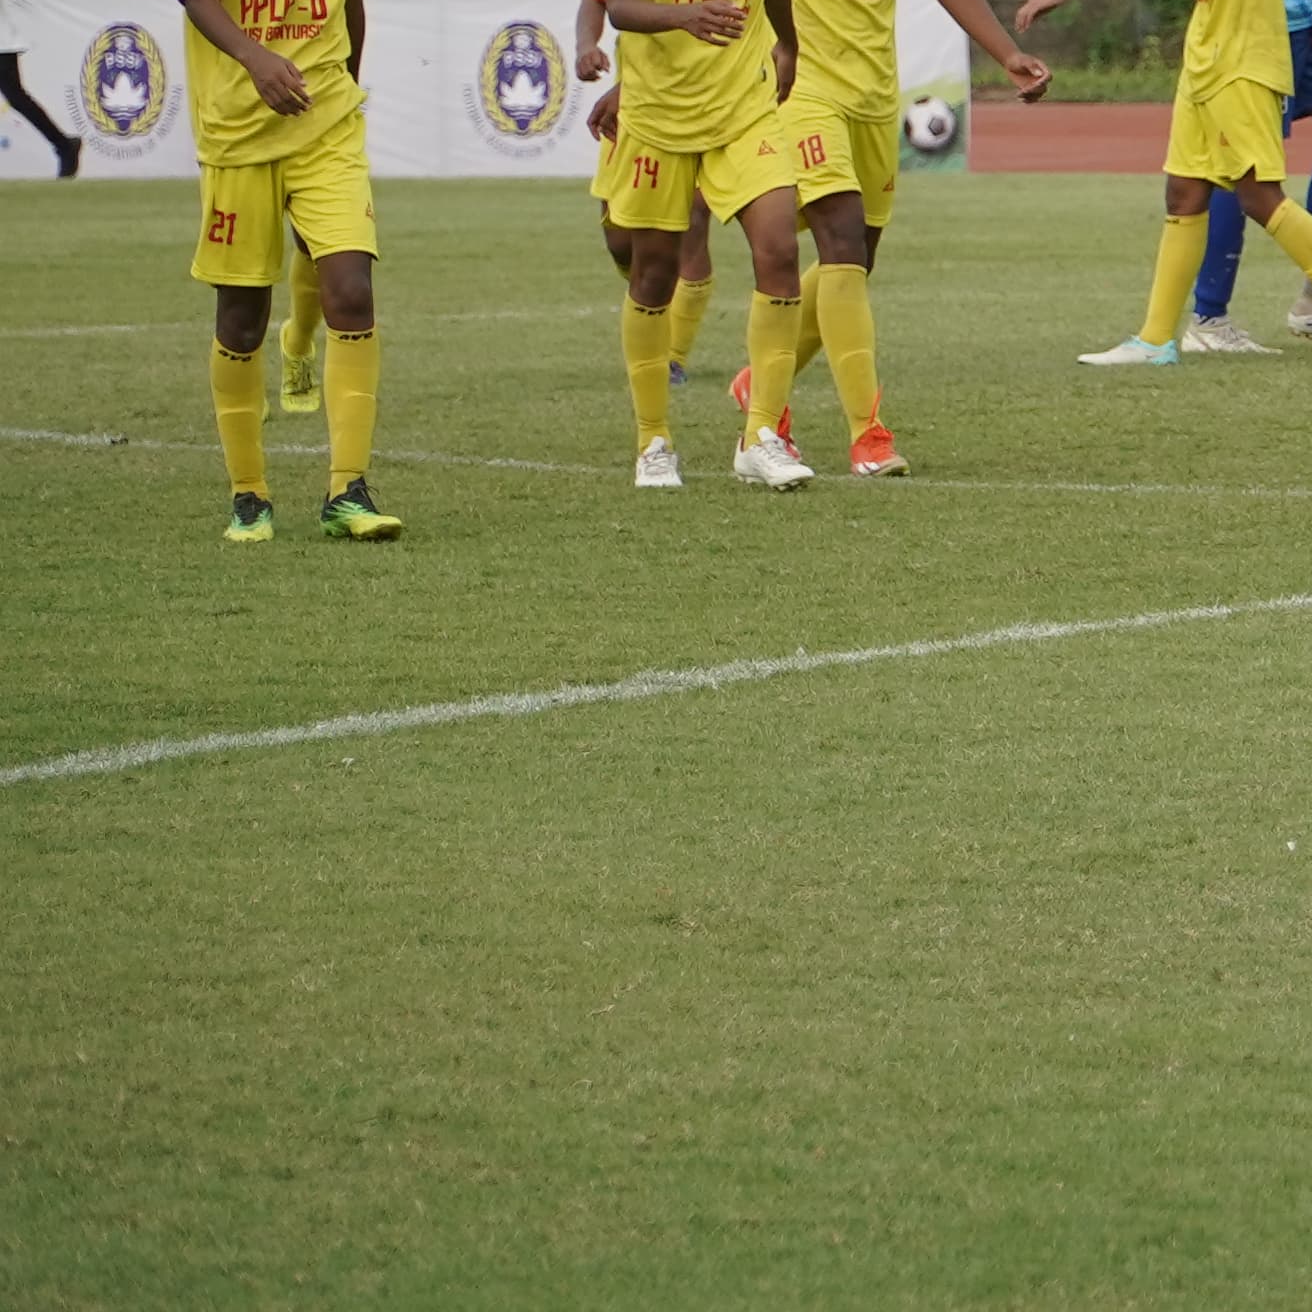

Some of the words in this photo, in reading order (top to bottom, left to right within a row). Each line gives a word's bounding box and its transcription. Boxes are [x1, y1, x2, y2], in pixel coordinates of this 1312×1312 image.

[244, 27, 262, 42] USI
[797, 135, 827, 170] 18
[632, 156, 659, 188] 14
[208, 208, 237, 245] 21
